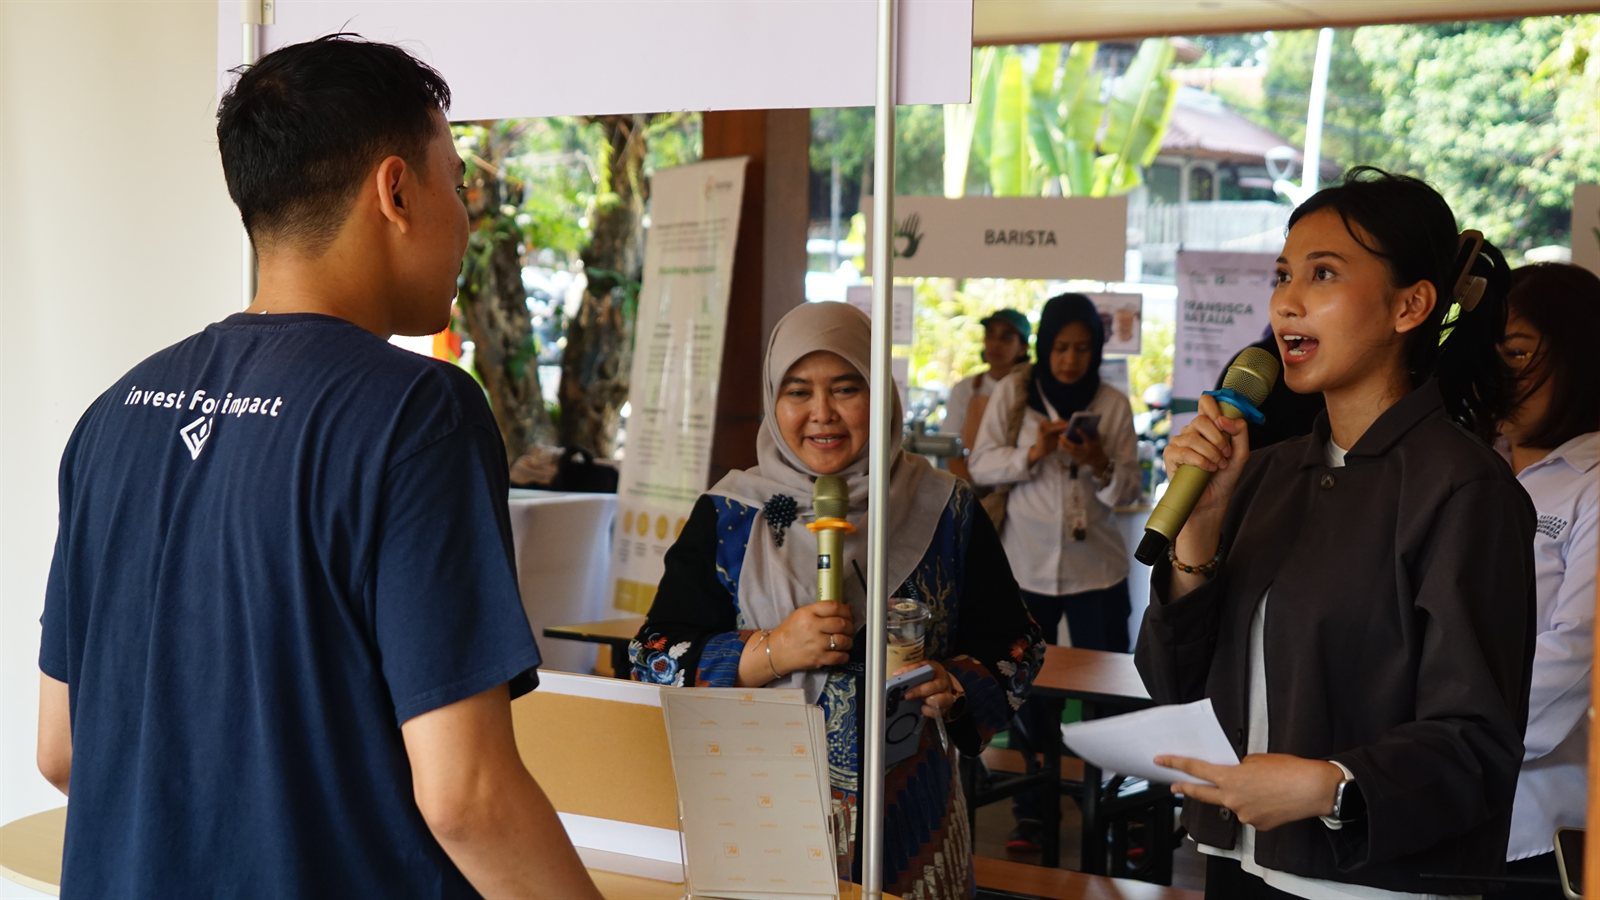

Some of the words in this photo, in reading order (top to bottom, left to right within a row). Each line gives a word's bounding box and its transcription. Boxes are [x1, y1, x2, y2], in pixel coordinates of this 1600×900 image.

[984, 229, 1058, 247] BARISTA
[124, 385, 186, 410] invest
[221, 392, 283, 418] impact
